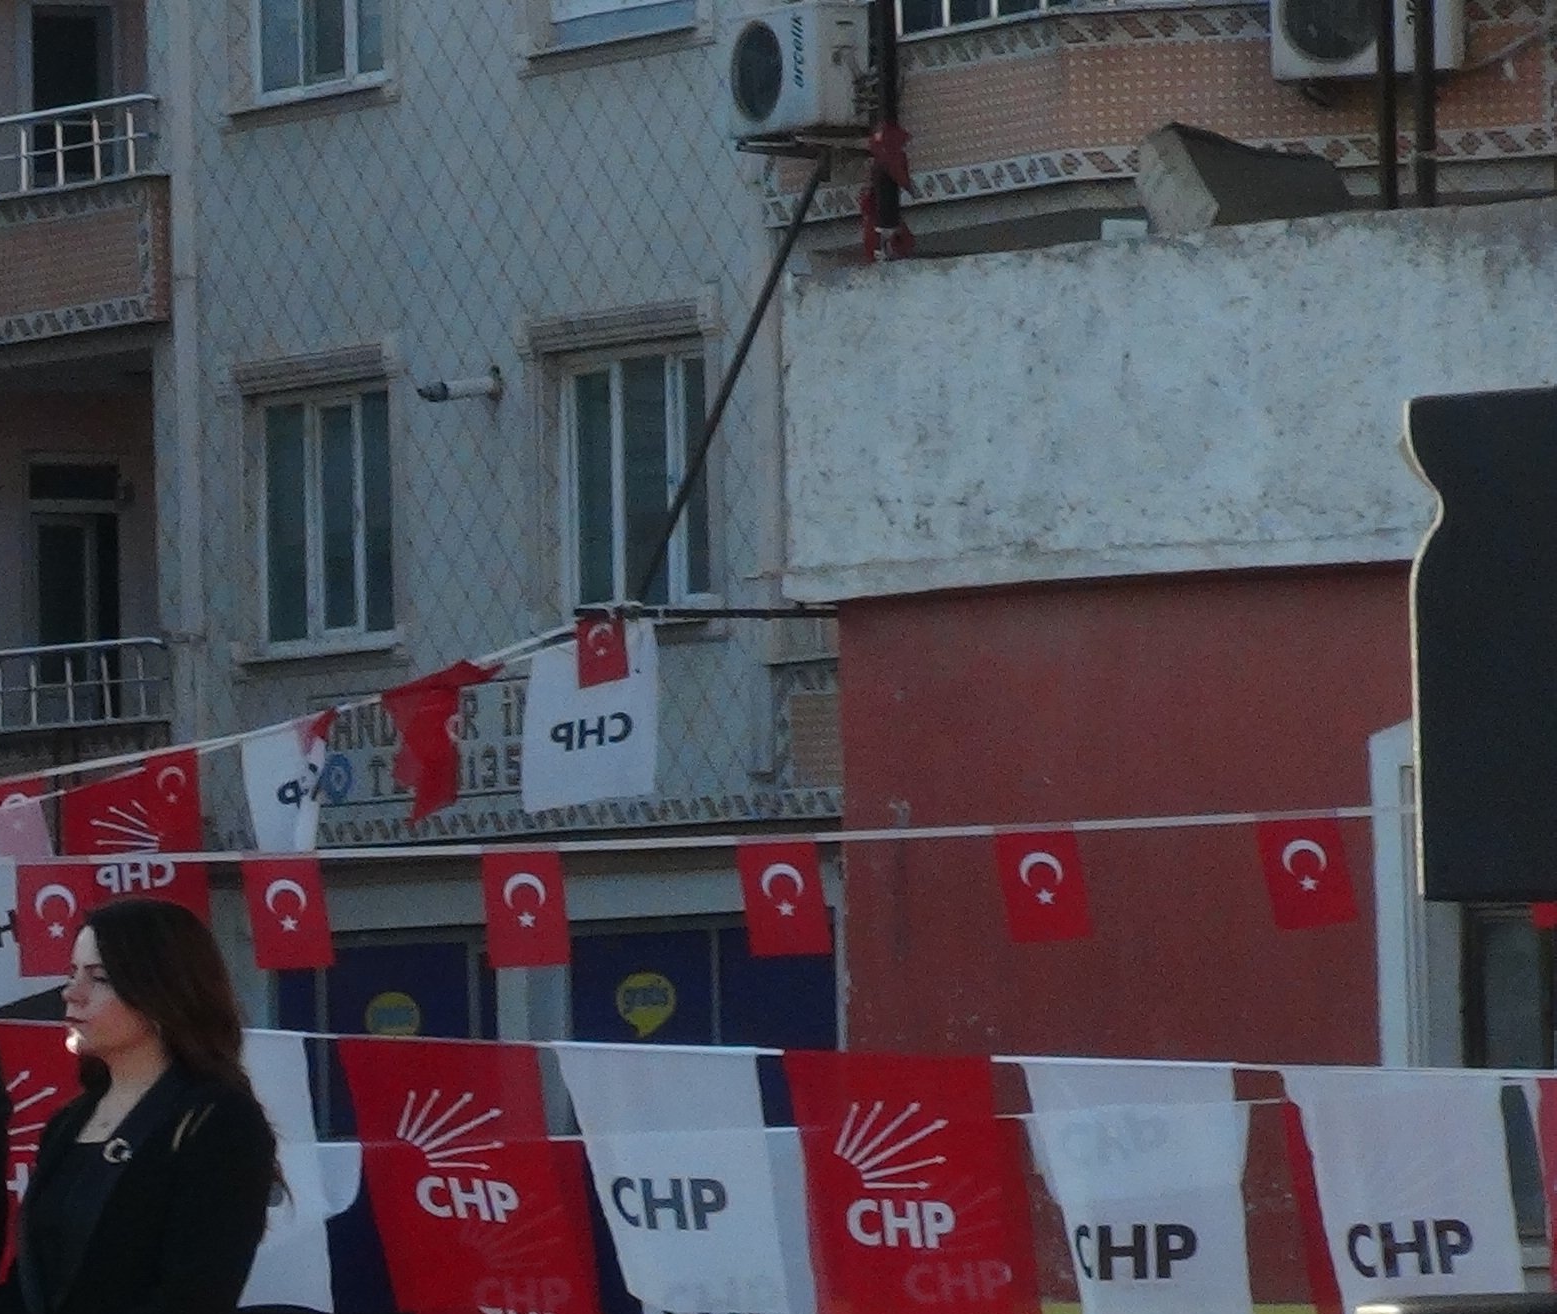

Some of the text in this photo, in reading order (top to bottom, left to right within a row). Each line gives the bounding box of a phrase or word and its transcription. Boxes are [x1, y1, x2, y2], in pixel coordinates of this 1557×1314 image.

[415, 1175, 520, 1224] CHP
[610, 1176, 728, 1231] CHP
[846, 1198, 957, 1249] CHP
[1075, 1223, 1198, 1281] CHP
[1346, 1217, 1475, 1280] CHP
